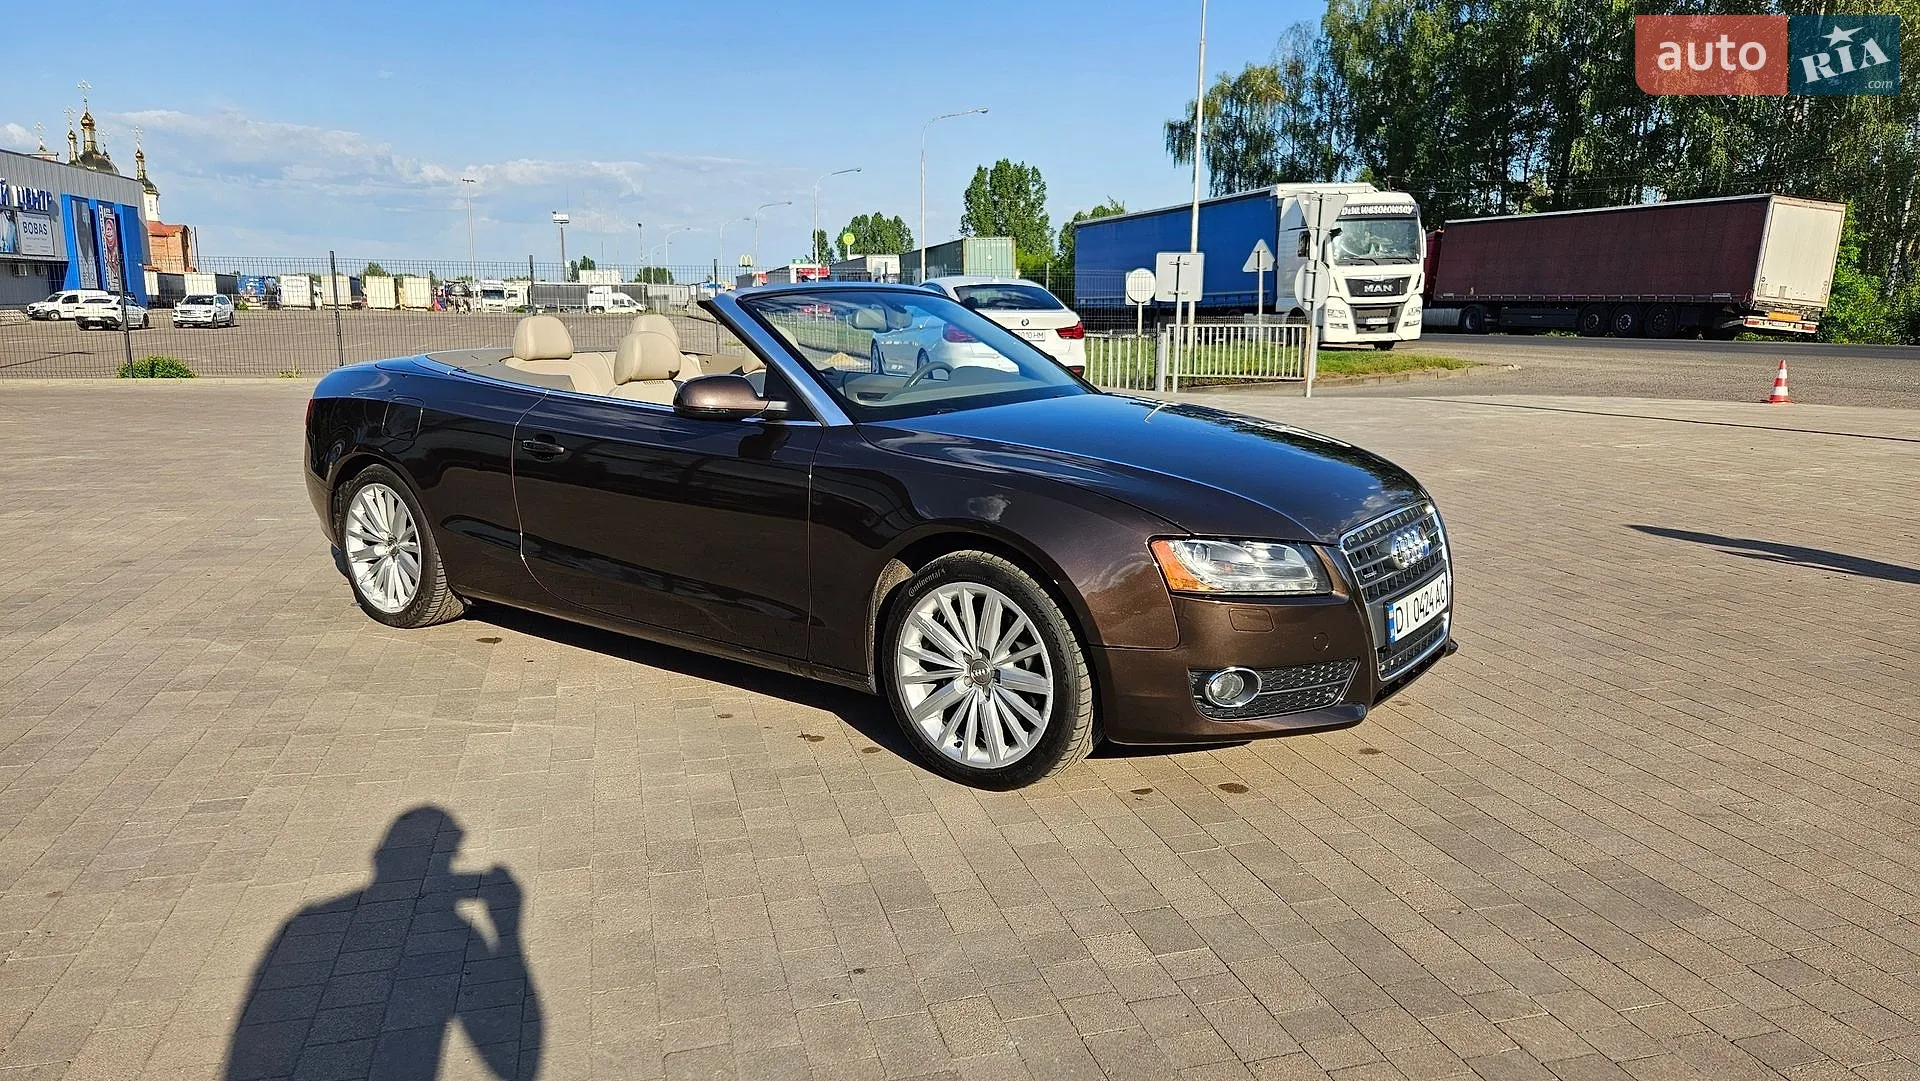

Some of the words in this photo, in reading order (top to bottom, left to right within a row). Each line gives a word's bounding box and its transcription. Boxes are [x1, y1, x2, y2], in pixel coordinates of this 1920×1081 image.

[11, 185, 53, 211] ЦЕНТР
[23, 221, 48, 235] BOBAS
[1364, 284, 1394, 293] MAN
[908, 569, 942, 597] Continental
[1395, 601, 1410, 635] DI
[1413, 587, 1435, 623] 0424
[1435, 579, 1446, 609] AC
